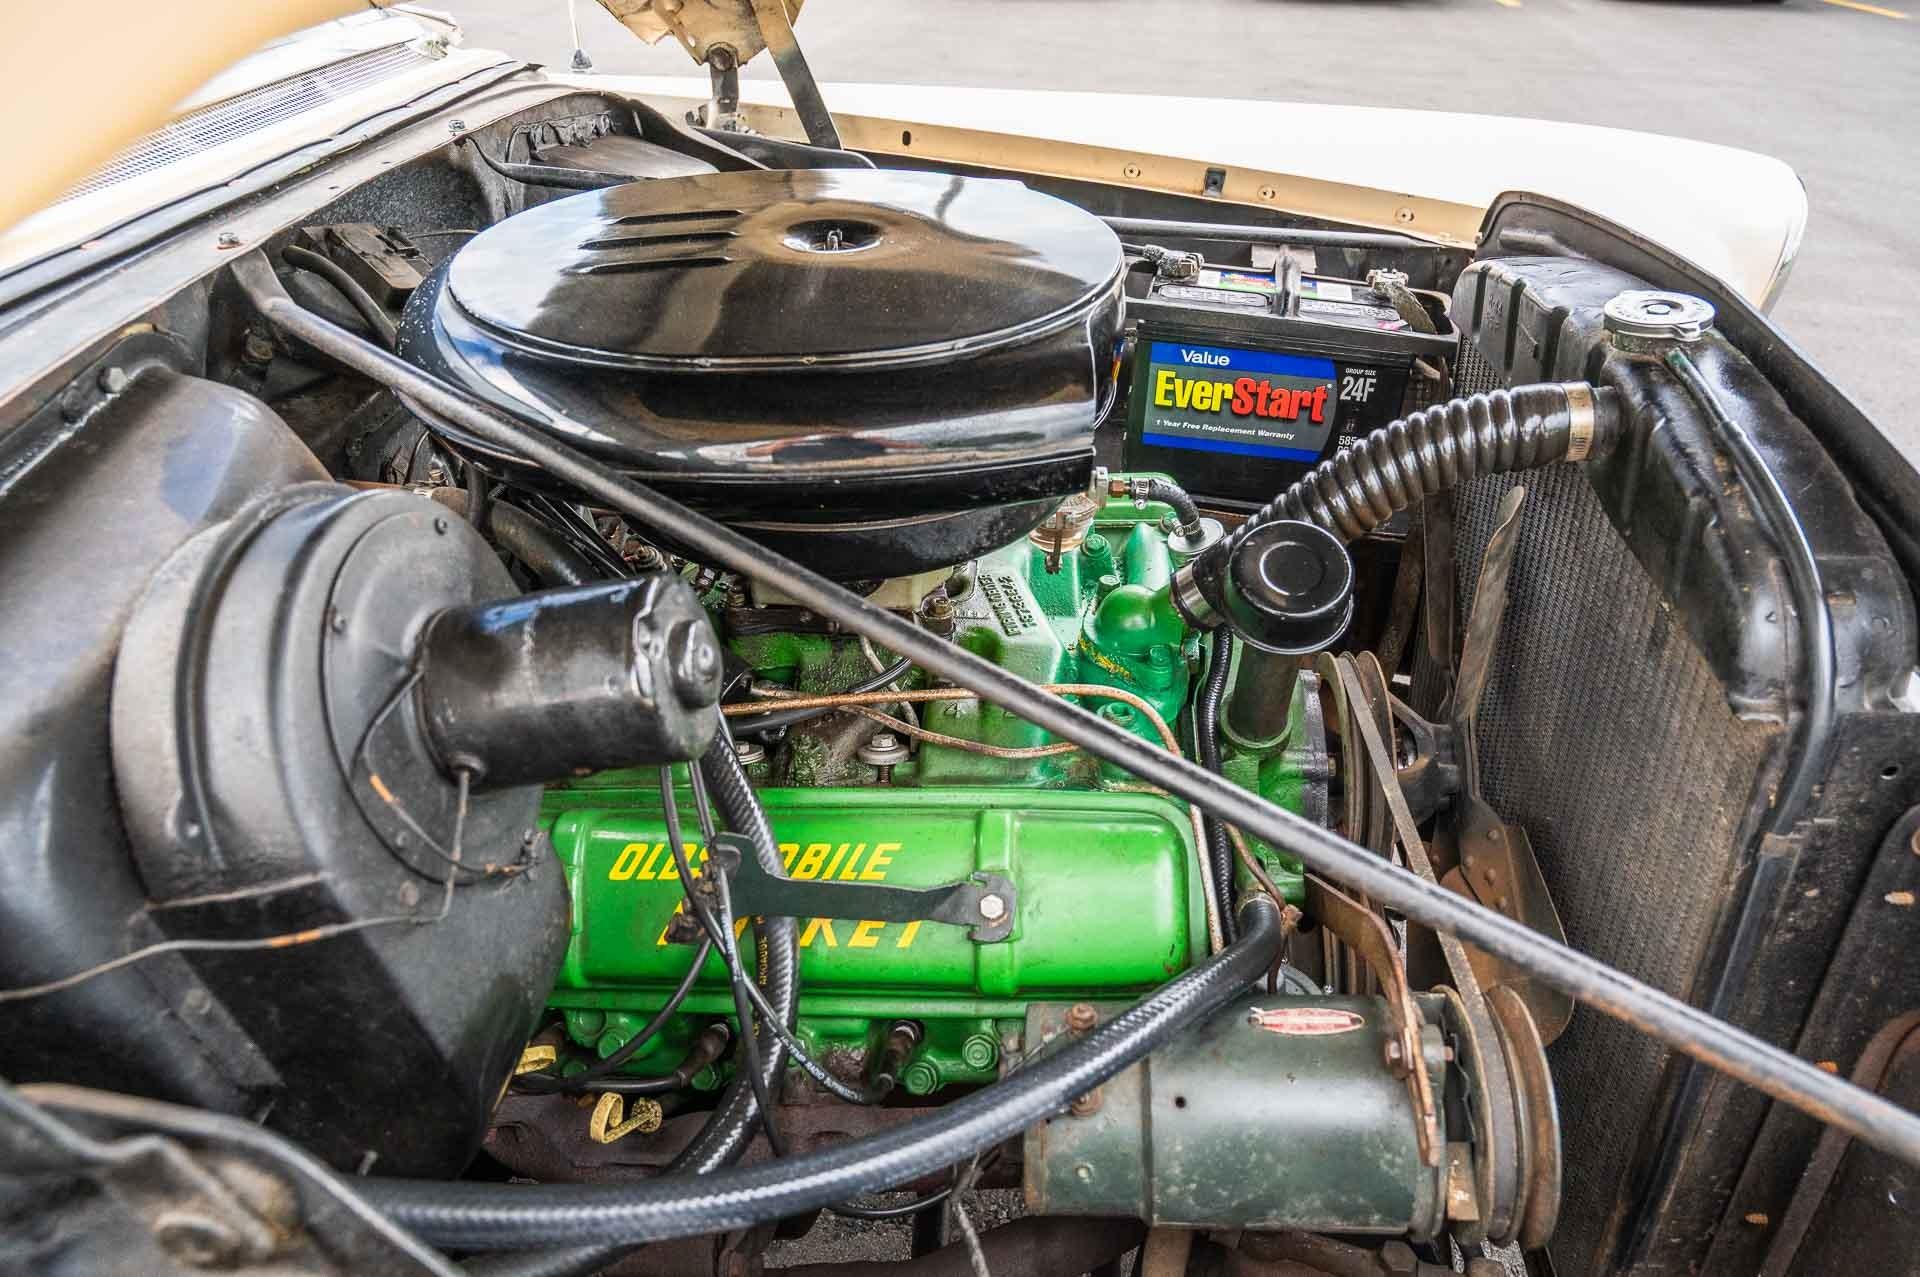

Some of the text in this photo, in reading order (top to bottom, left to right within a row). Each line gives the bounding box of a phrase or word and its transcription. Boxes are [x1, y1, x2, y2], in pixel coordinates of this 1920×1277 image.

[1181, 349, 1230, 366] Value
[1345, 367, 1377, 377] GROUP SIZE
[1154, 369, 1328, 423] EverStart
[1340, 376, 1377, 402] 24F
[1163, 419, 1181, 428] Year
[1182, 421, 1201, 431] Free
[1201, 423, 1256, 436] Replacement
[1257, 428, 1296, 441] Warranty
[608, 842, 902, 881] OLDOBILE
